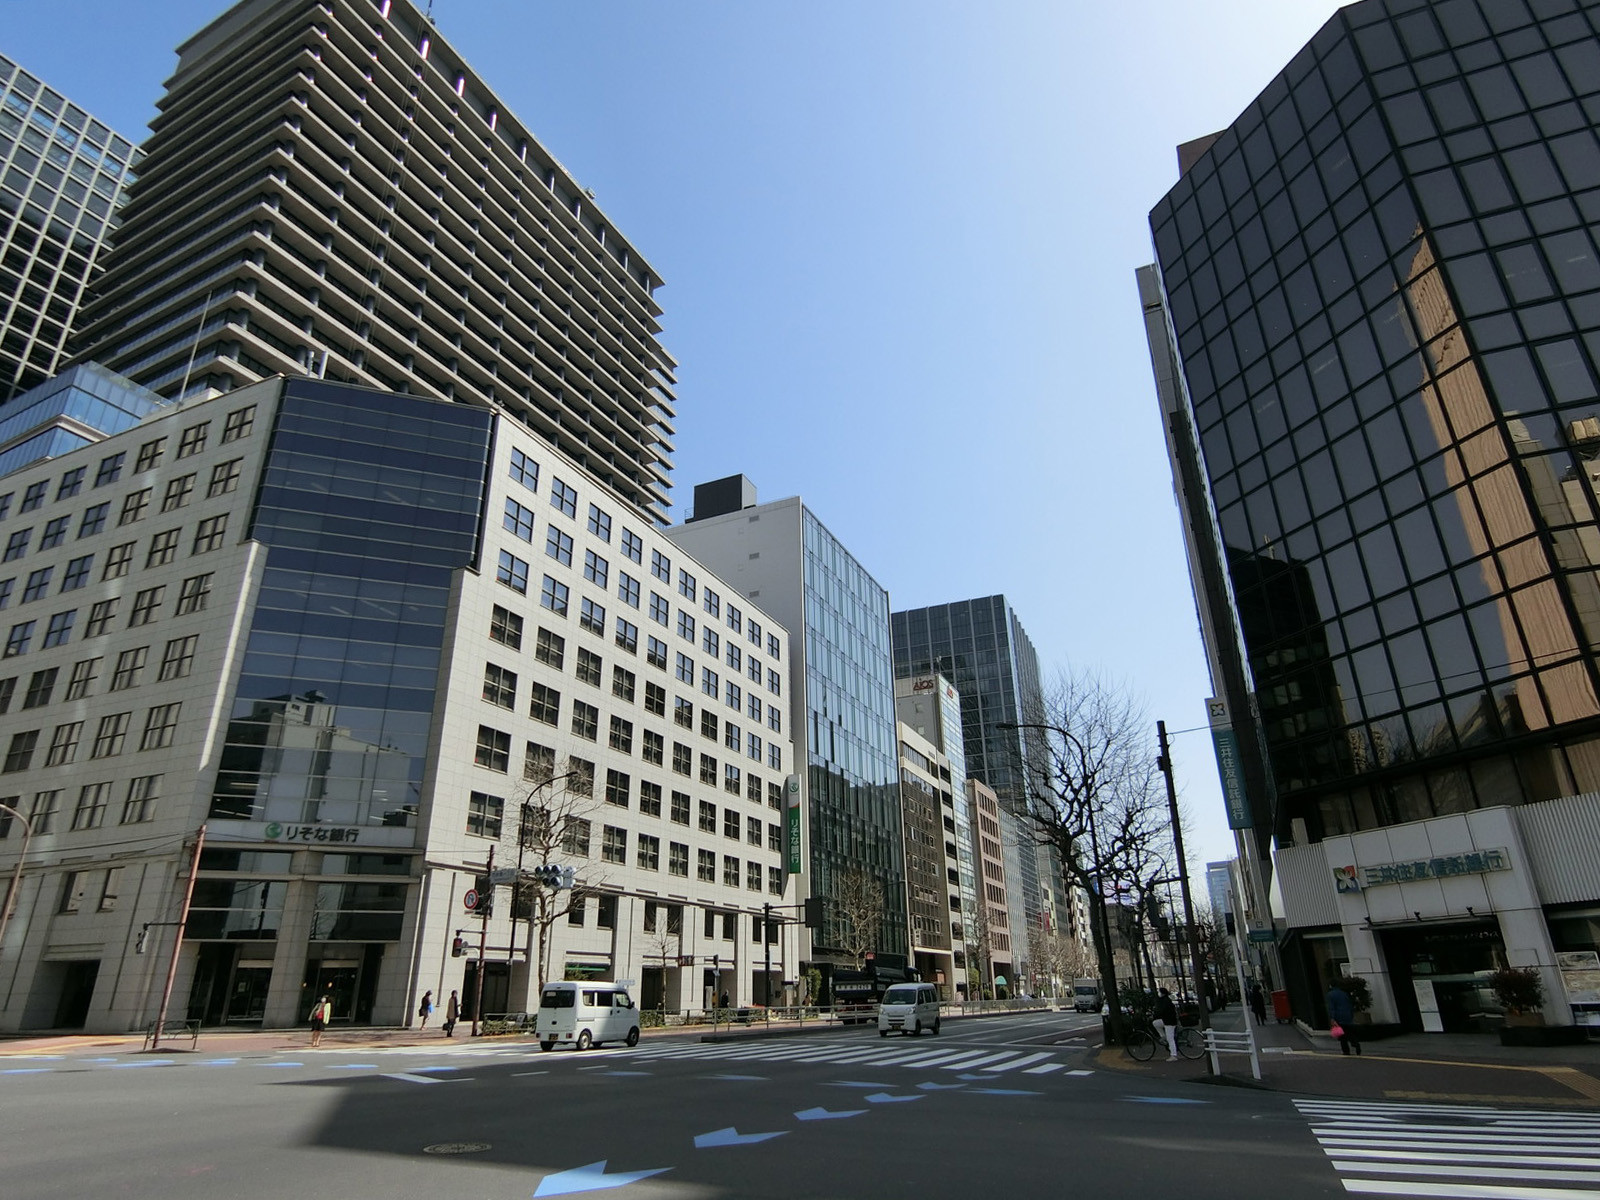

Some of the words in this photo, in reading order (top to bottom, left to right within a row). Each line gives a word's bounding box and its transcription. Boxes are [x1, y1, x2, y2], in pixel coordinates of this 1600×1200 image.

[1219, 738, 1244, 820] 三井住友信託銀行
[286, 826, 359, 842] りそな銀行
[790, 819, 799, 864] りそな銀行
[1364, 850, 1504, 885] 三井住友信託銀行
